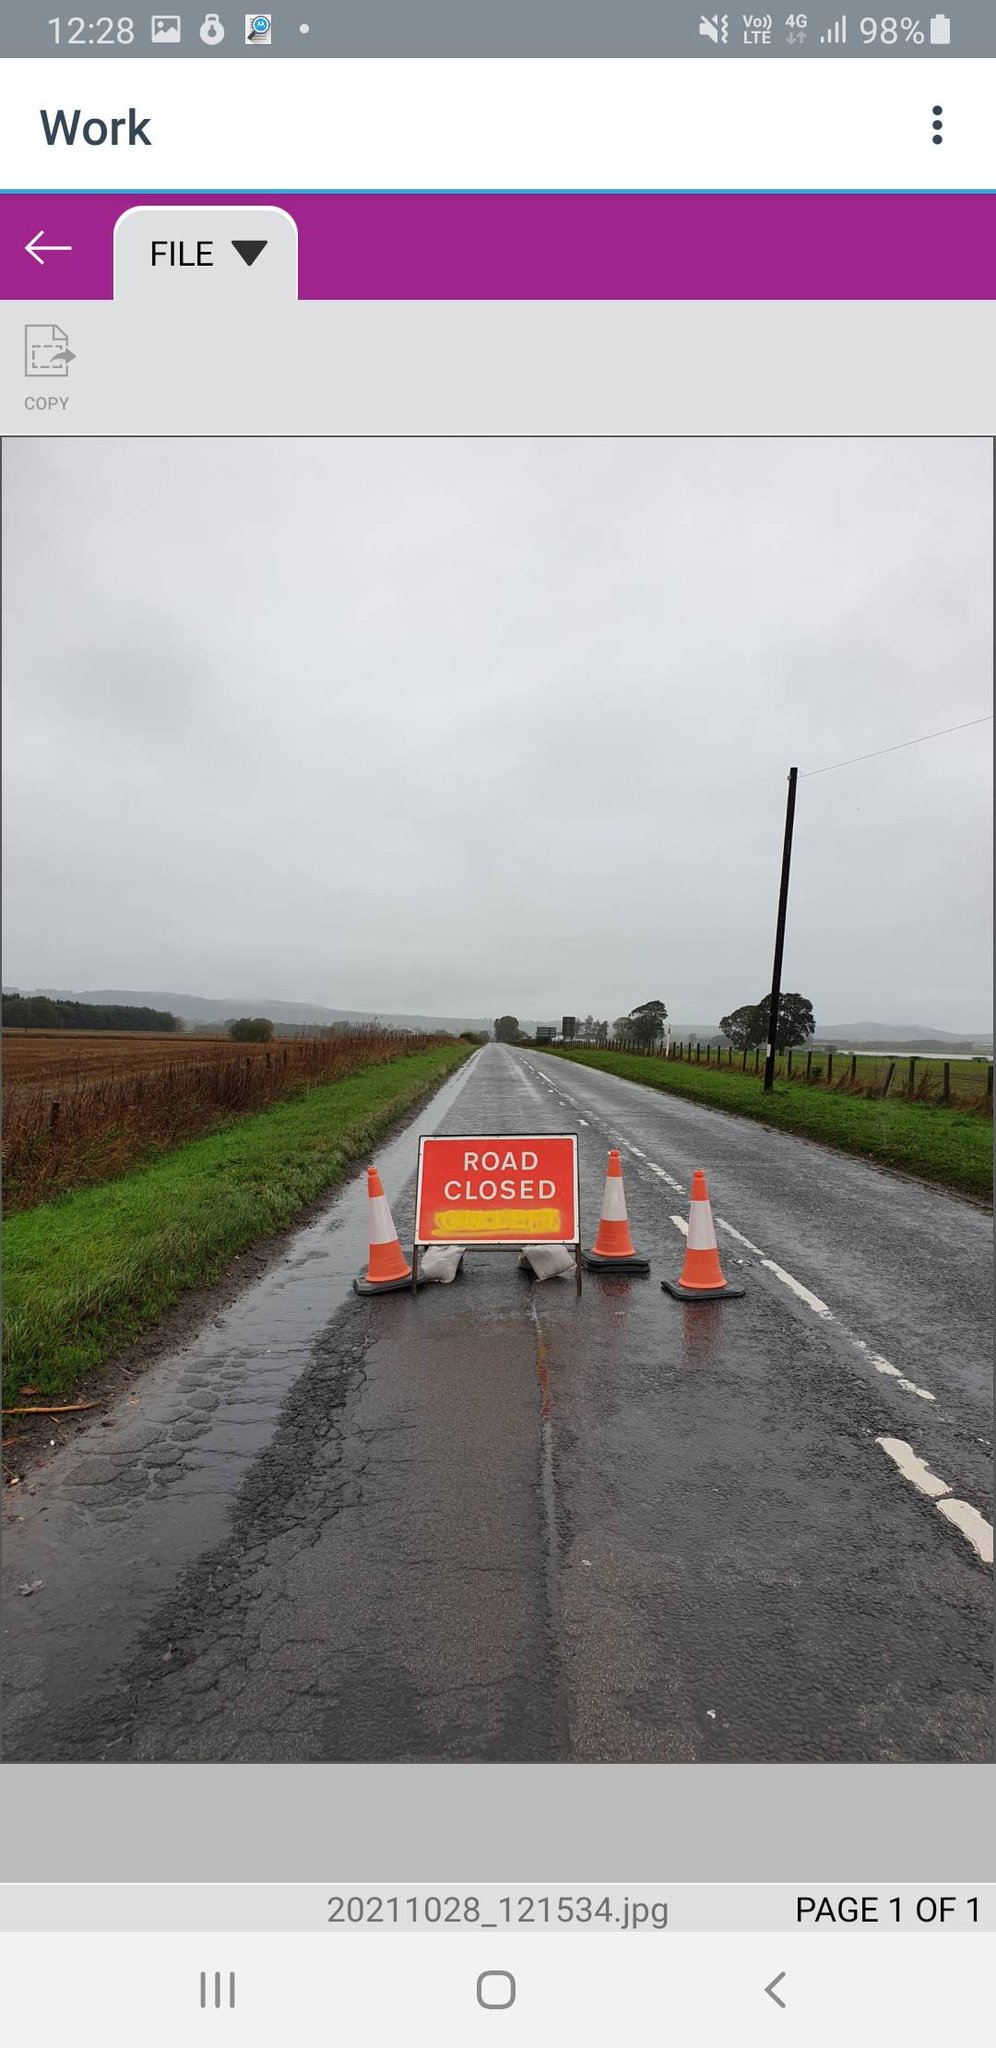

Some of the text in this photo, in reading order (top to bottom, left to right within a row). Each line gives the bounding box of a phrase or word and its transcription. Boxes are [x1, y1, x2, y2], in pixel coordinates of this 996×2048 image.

[48, 16, 135, 44] 12:28
[785, 14, 808, 28] 4G
[859, 16, 925, 44] 98%
[743, 31, 771, 44] LTE
[39, 108, 152, 146] Work
[151, 240, 214, 266] FILE
[23, 396, 69, 411] COPY
[463, 1151, 539, 1172] ROAD
[444, 1179, 556, 1201] CLOSED
[326, 1896, 668, 1928] 20211028_121534.jpg
[796, 1896, 977, 1923] PAGE 1 OF 1
